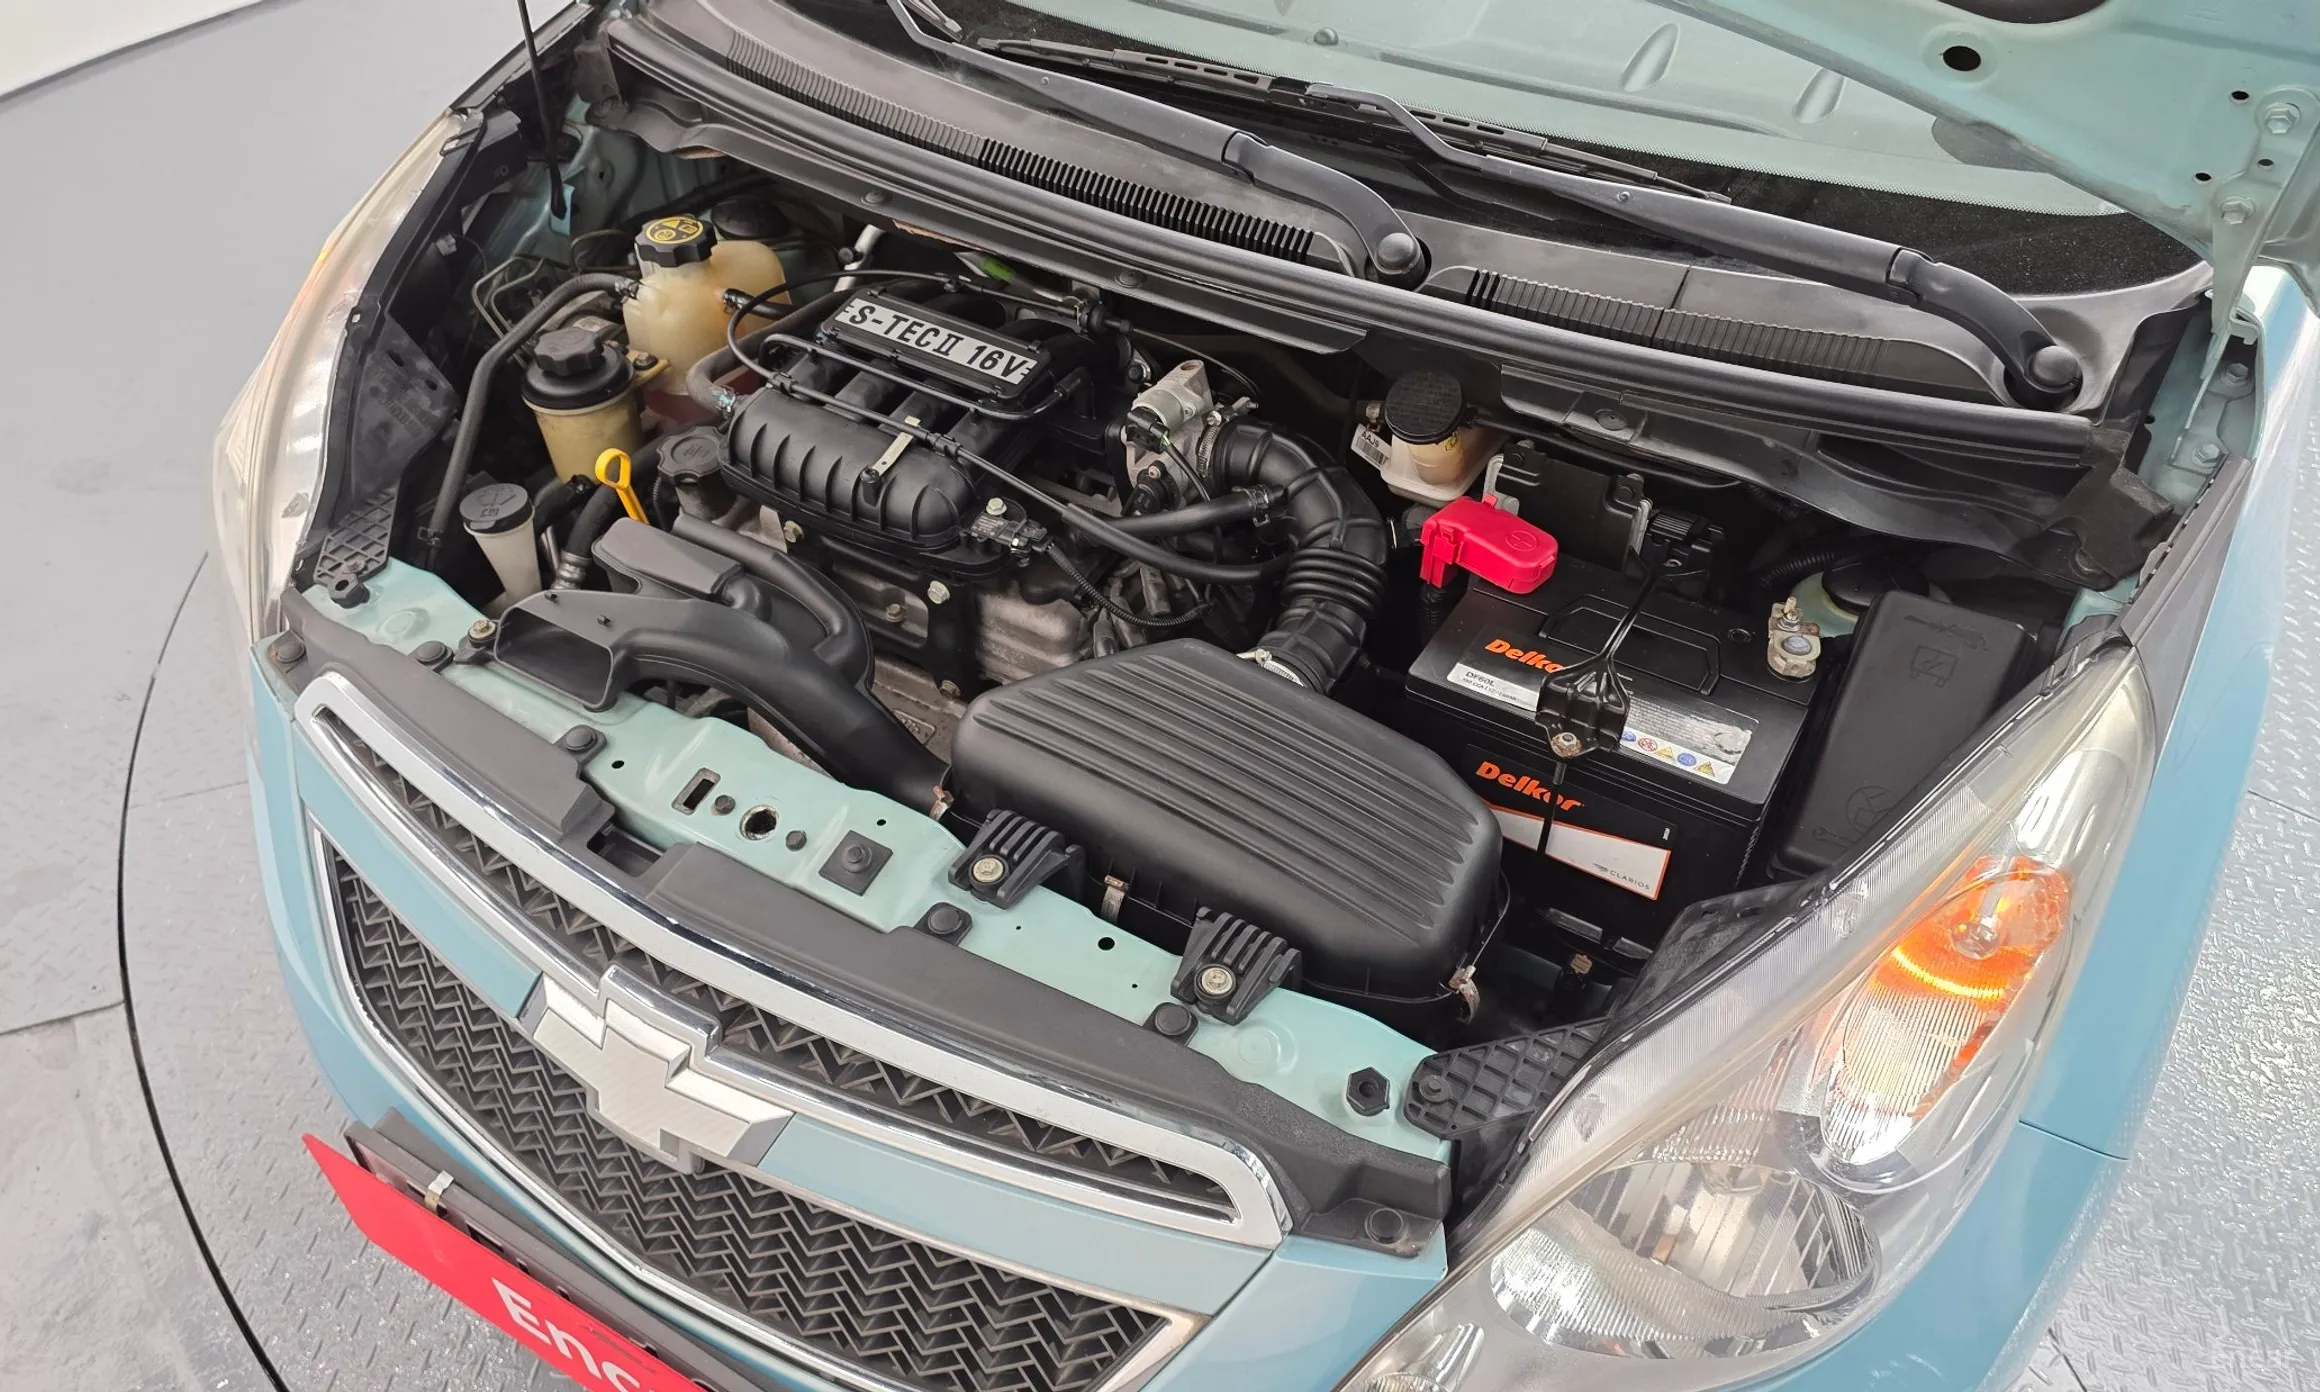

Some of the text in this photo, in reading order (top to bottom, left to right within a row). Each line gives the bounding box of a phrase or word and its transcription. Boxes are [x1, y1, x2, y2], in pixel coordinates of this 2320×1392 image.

[965, 345, 1028, 378] 16V
[1485, 639, 1564, 674] Delko
[1610, 869, 1650, 890] CLARIOS
[491, 1277, 655, 1392] Enc
